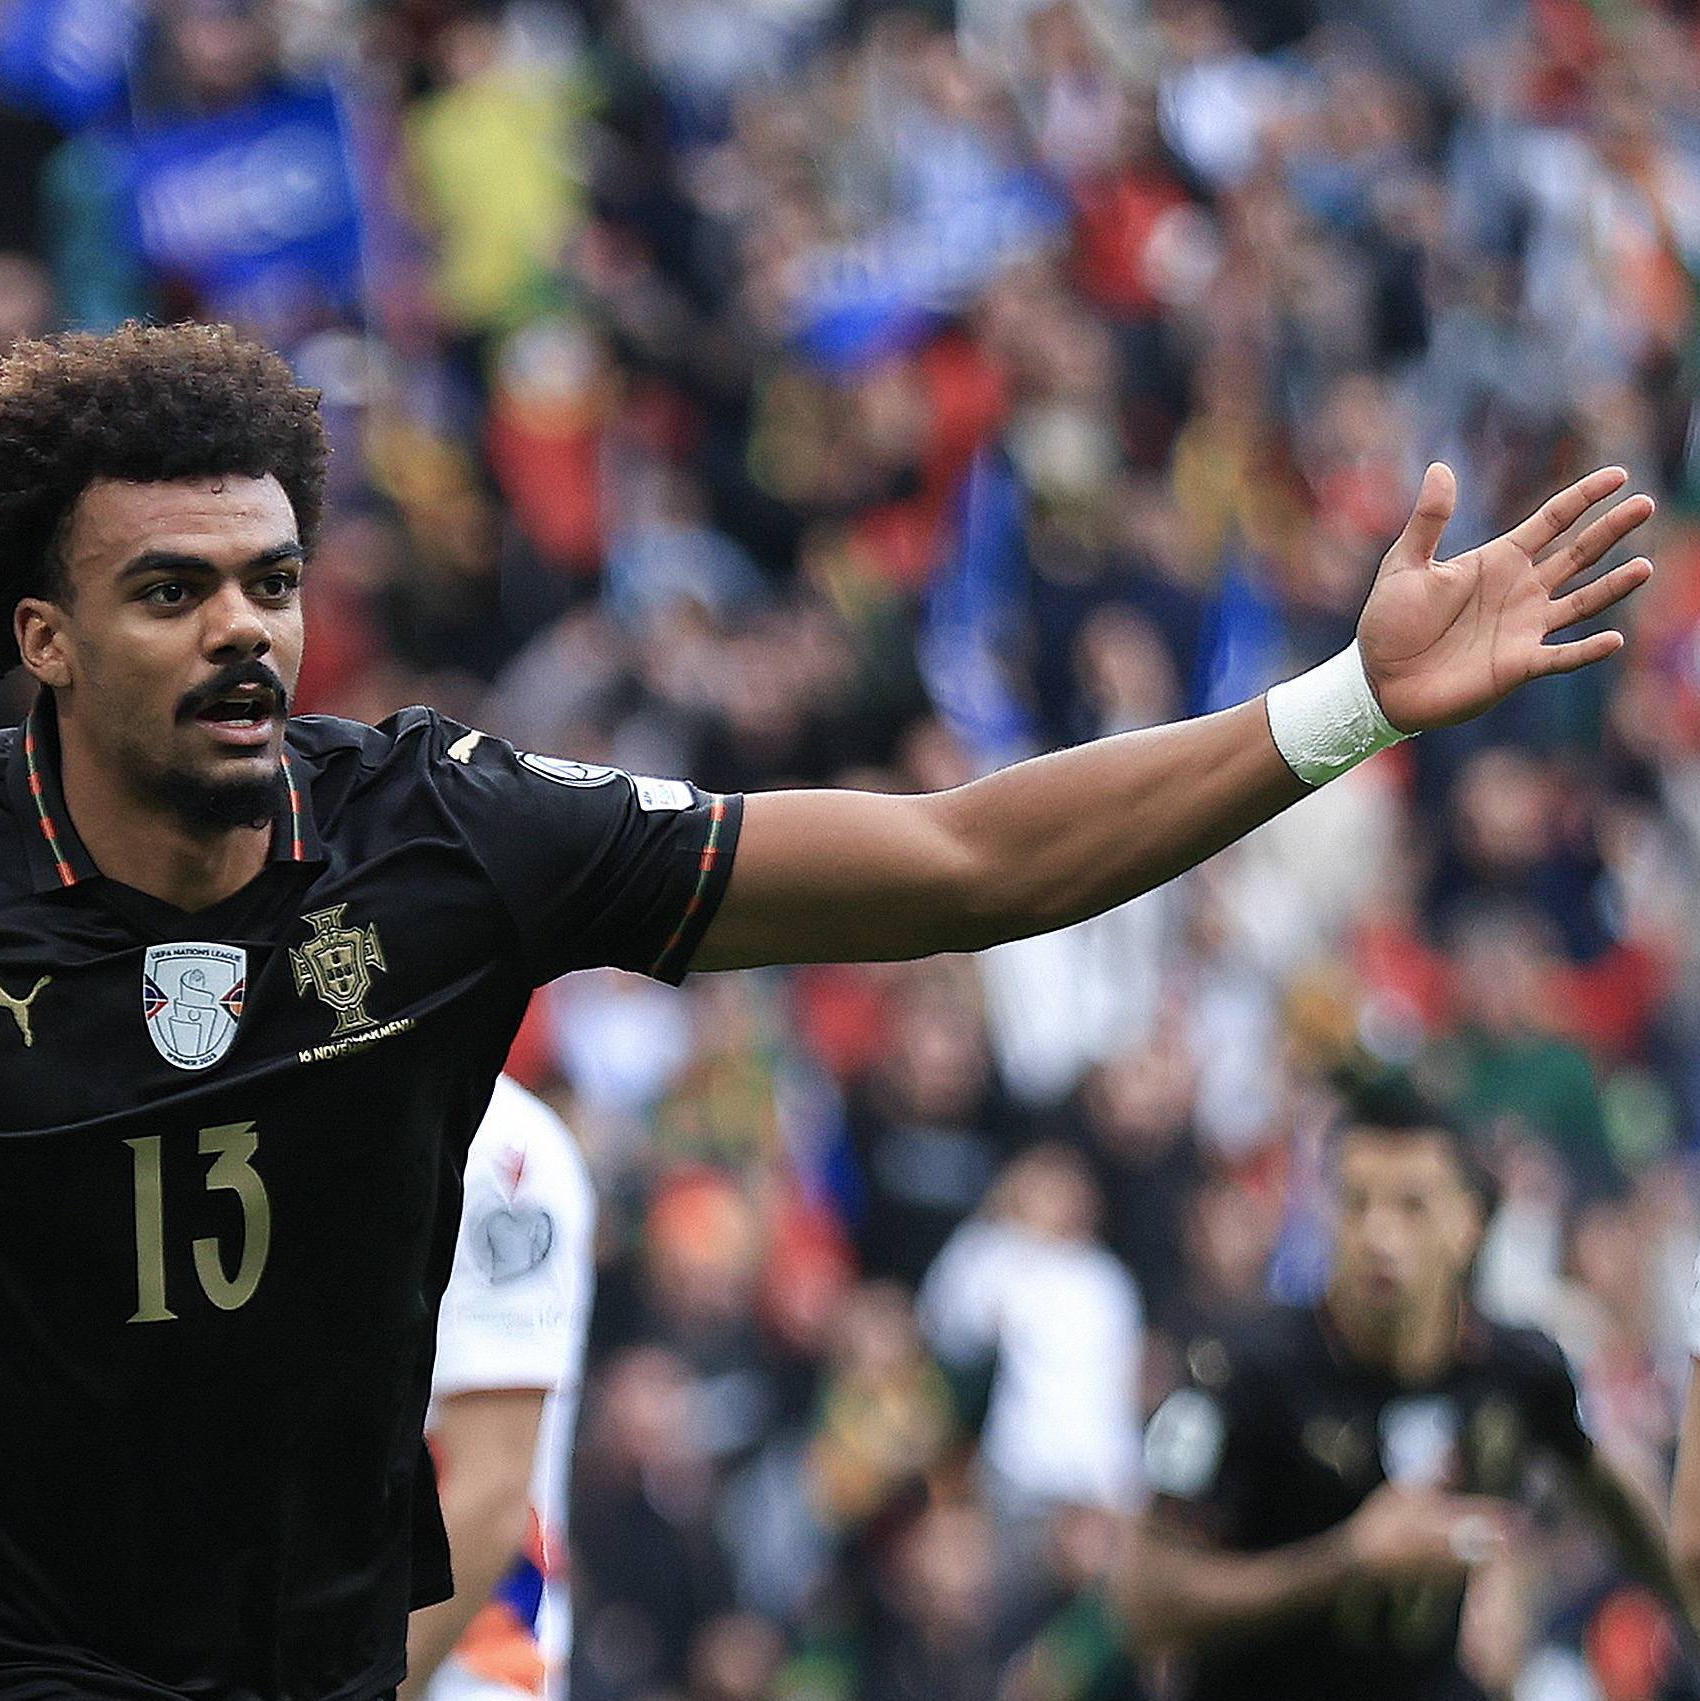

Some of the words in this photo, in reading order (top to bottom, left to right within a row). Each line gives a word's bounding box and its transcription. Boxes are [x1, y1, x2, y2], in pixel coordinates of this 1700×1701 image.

[150, 949, 171, 960] UEFA
[173, 948, 209, 957] NATIONS
[211, 950, 242, 962] LEAGUE
[298, 1049, 312, 1063] 16
[121, 1120, 271, 1324] 13
